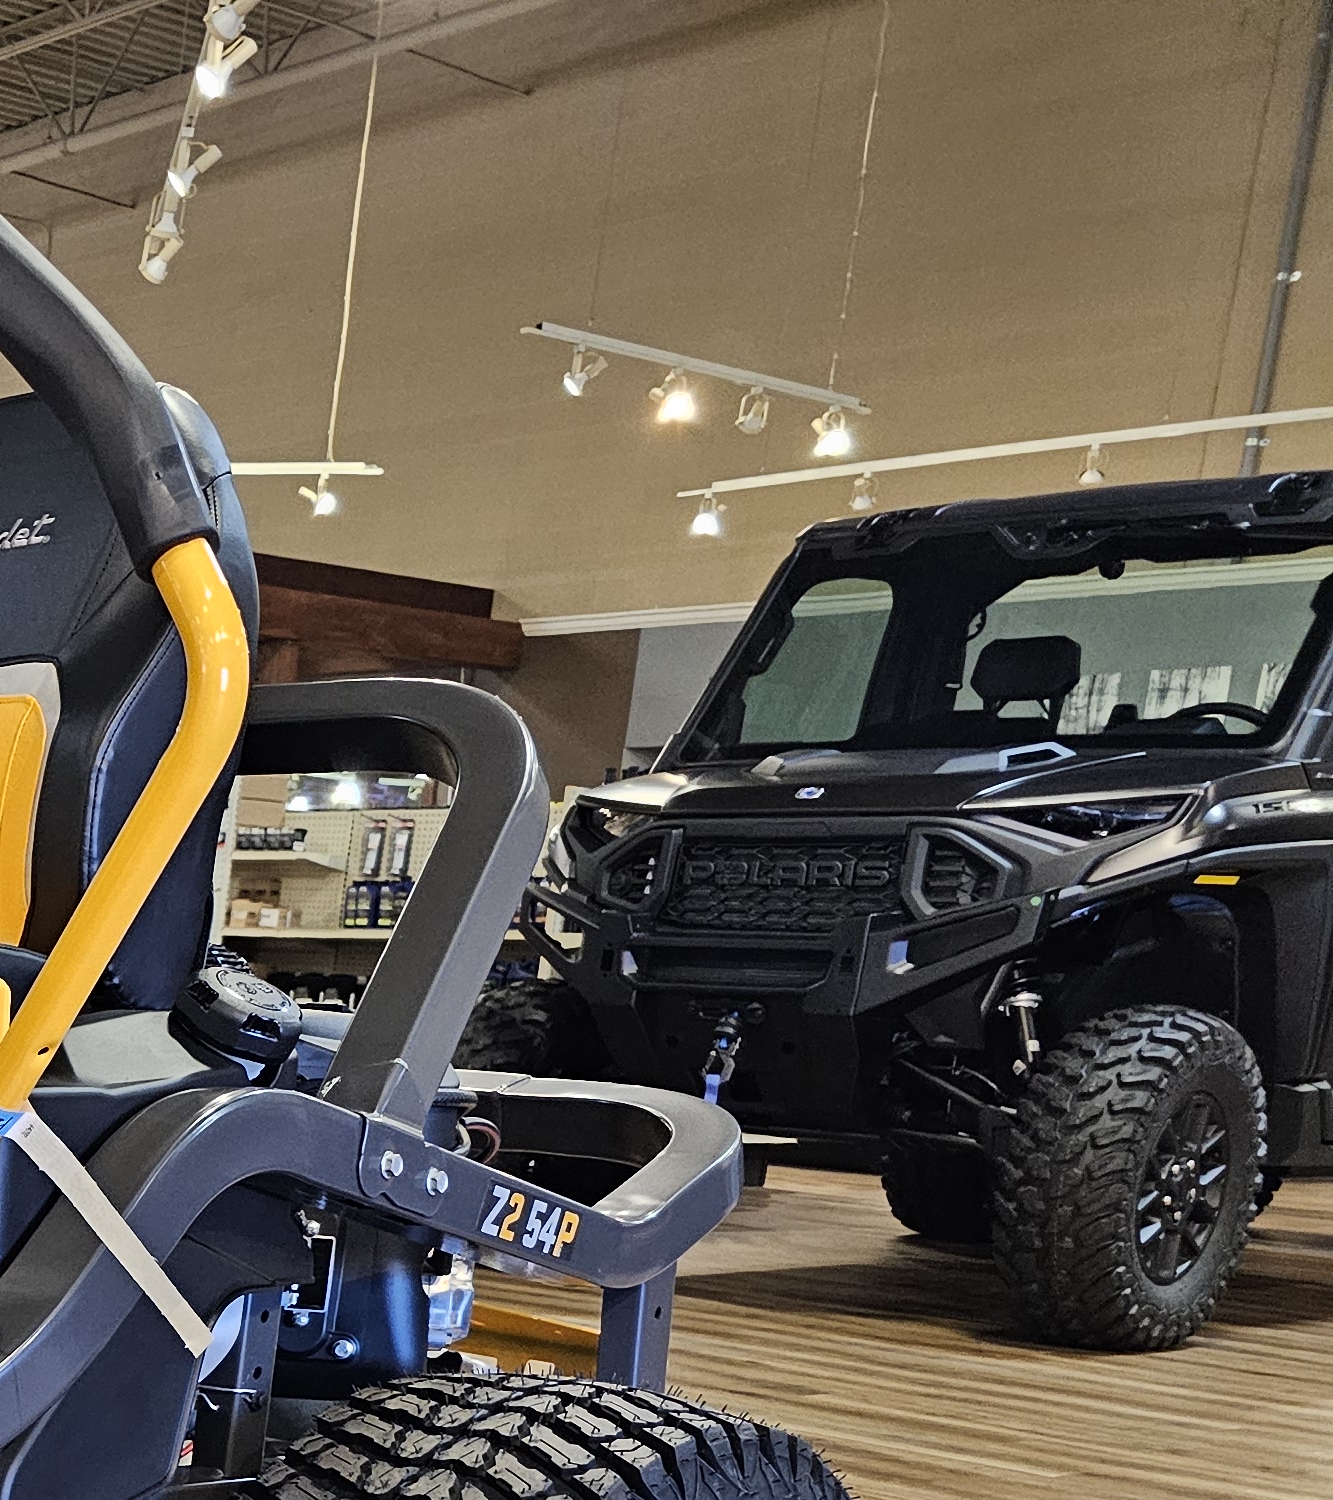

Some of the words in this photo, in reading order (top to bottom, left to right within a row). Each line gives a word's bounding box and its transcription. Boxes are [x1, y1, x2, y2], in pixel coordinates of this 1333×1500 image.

[683, 858, 890, 888] POLARIS
[480, 1184, 526, 1243] Z2
[522, 1199, 580, 1258] 54P
